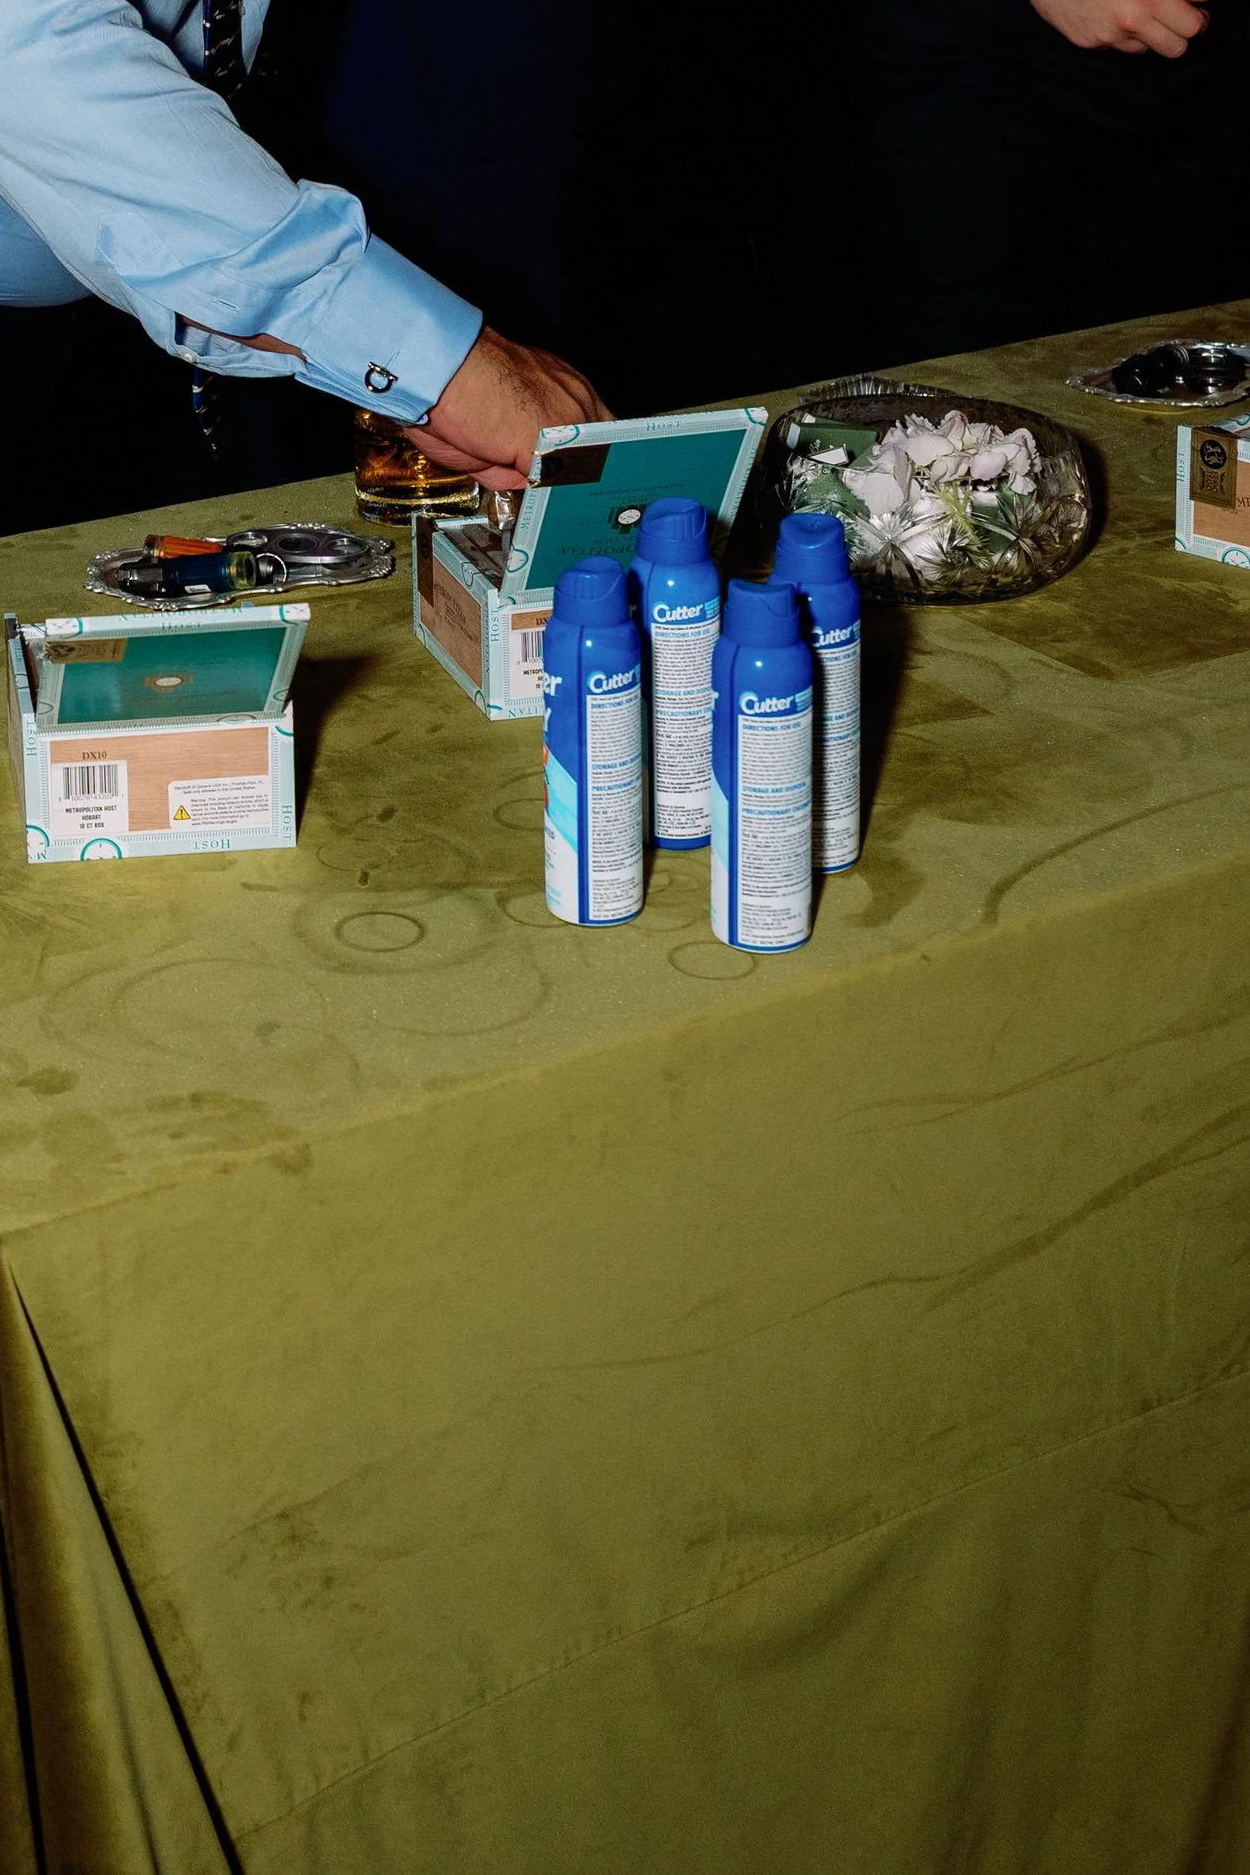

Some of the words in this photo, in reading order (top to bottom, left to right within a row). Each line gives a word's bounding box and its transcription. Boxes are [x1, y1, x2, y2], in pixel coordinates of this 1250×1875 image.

[646, 421, 683, 431] HOST
[1177, 452, 1186, 482] HOST
[558, 545, 634, 555] OPOLITAN
[653, 603, 704, 623] Cutter
[654, 631, 690, 639] DIRECTIONS
[691, 629, 701, 637] FOR
[812, 626, 852, 647] Cutter
[590, 669, 634, 693] Cutter
[654, 689, 681, 697] STORAGE
[740, 693, 794, 715] Cutter
[780, 723, 791, 731] FOR
[26, 721, 37, 756] HOST
[82, 751, 107, 760] DX10
[66, 805, 103, 813] METROPOLITAN
[282, 805, 292, 840] HOST
[192, 839, 231, 850] HOST
